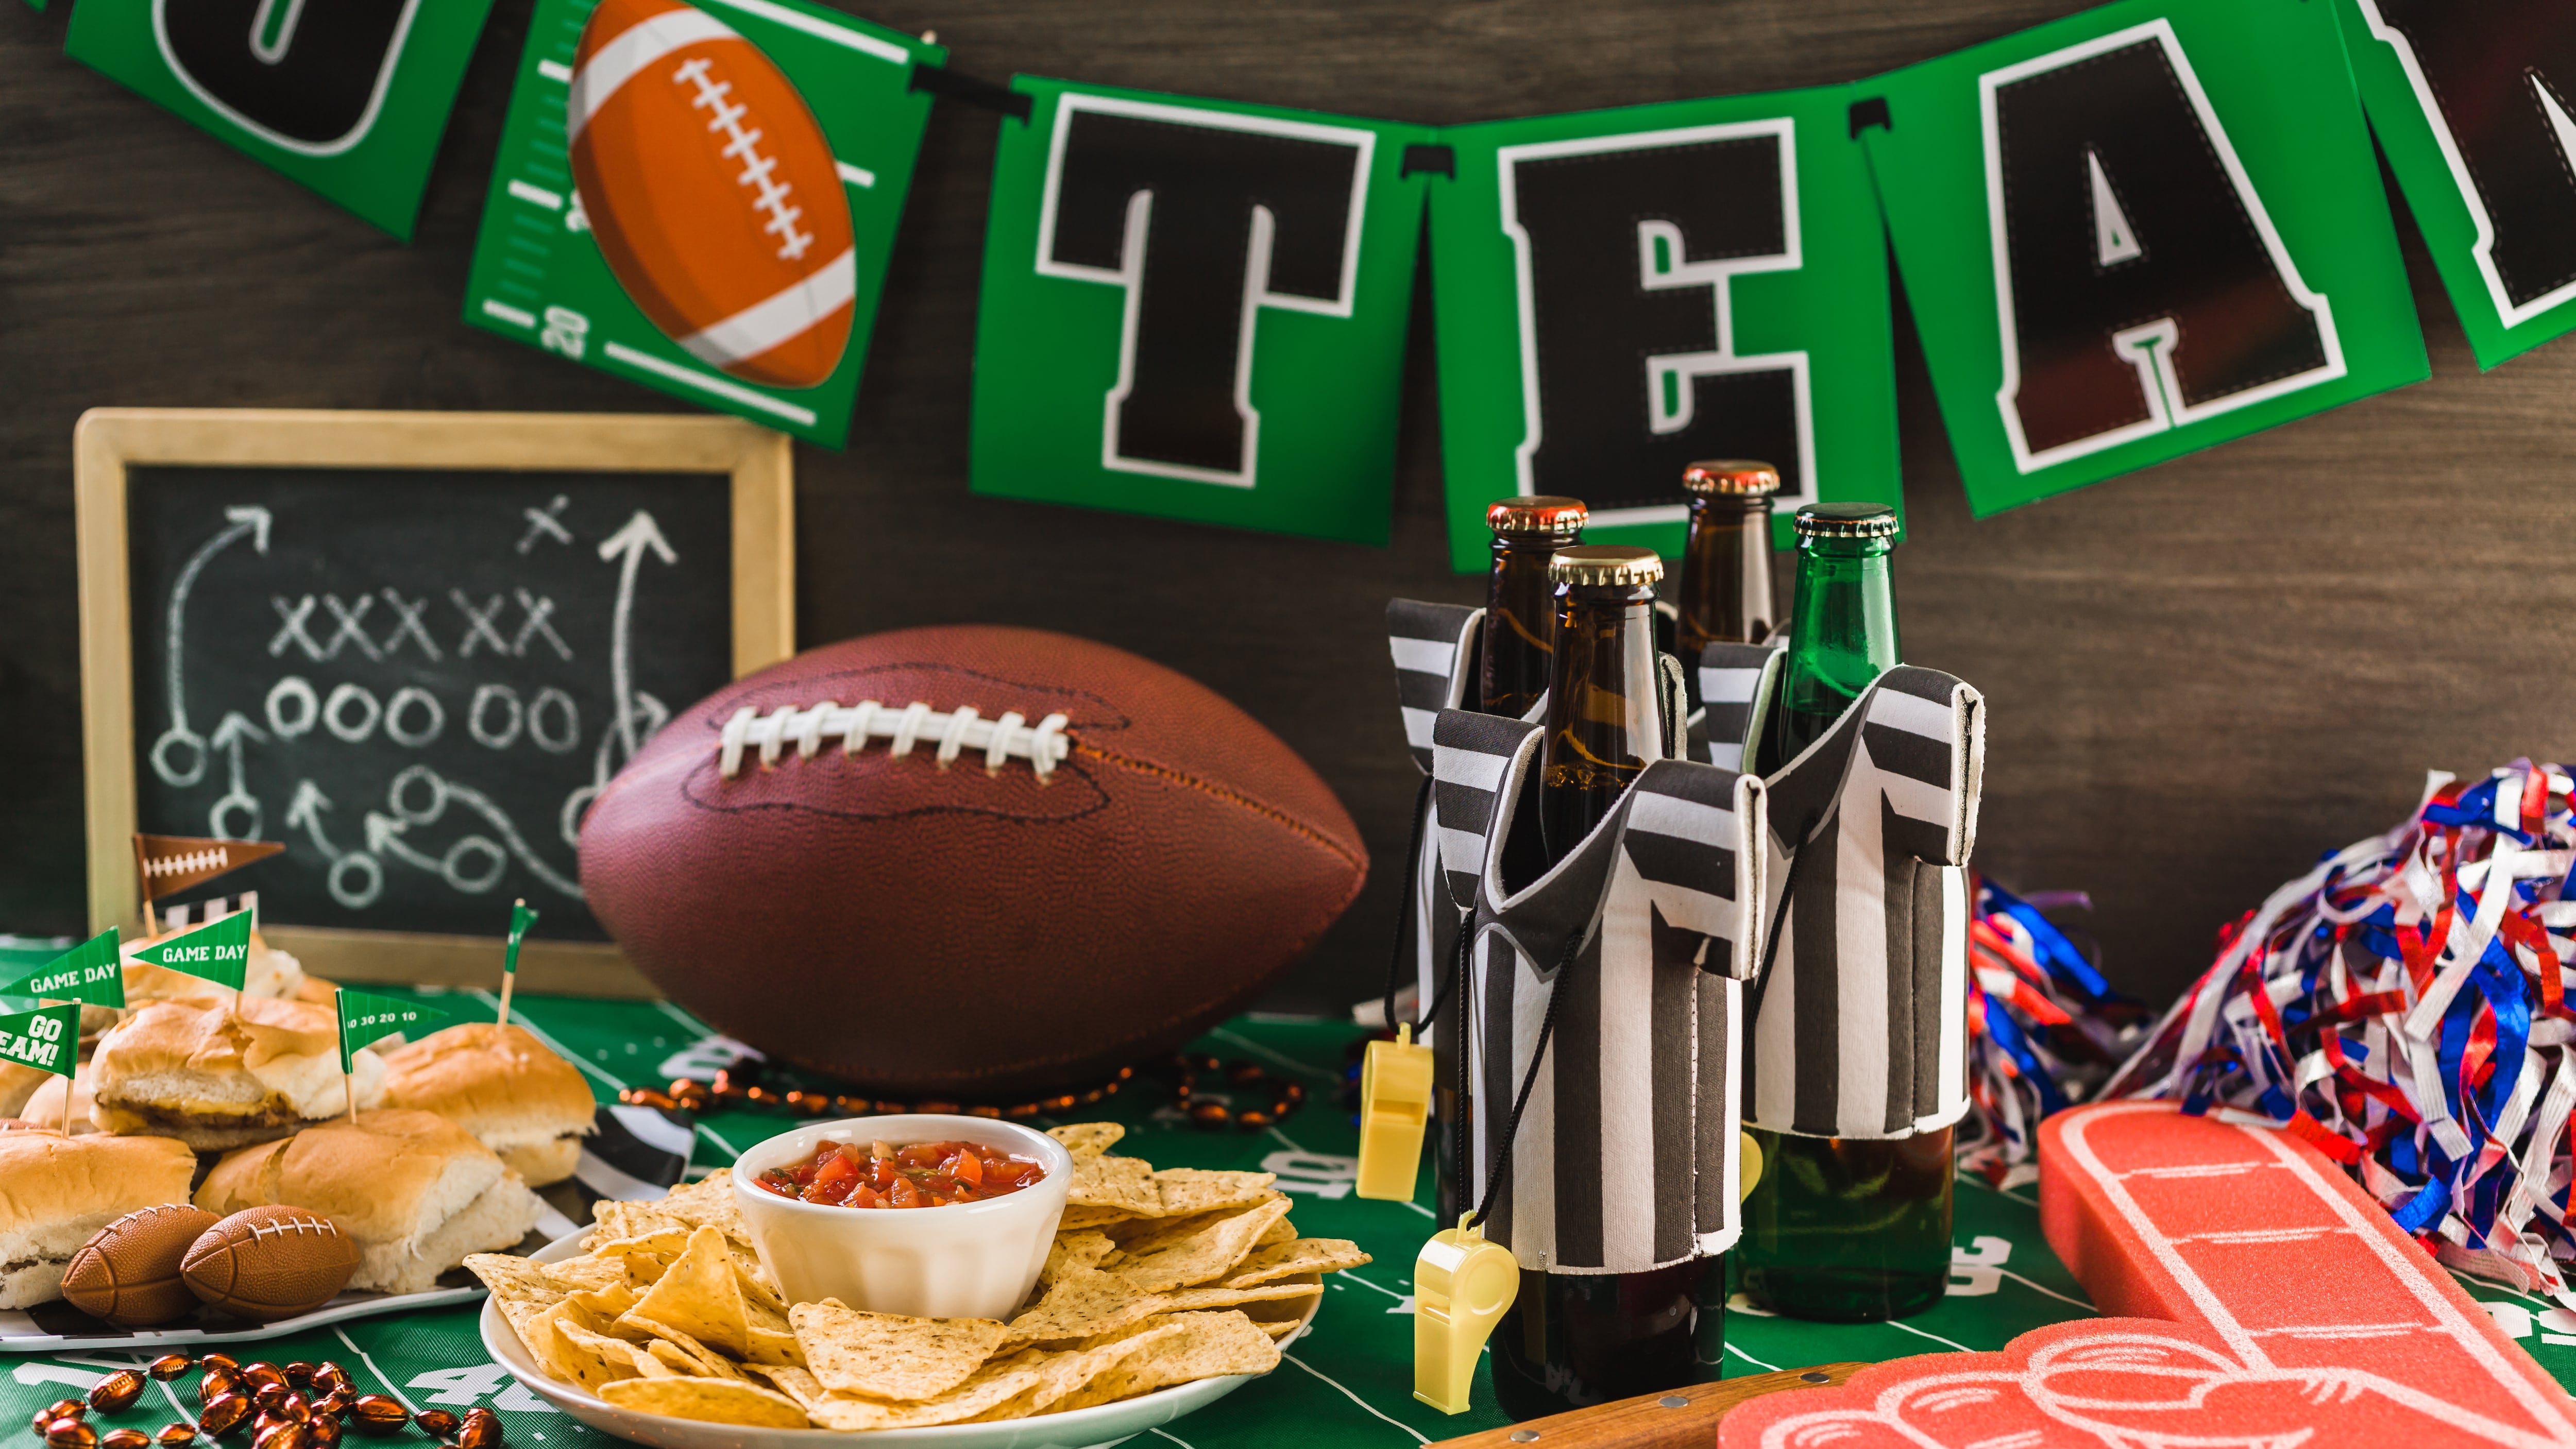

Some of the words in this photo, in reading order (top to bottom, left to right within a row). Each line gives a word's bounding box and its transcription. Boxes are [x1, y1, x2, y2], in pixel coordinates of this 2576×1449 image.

[162, 946, 210, 963] GAME
[215, 944, 246, 961] DAY
[30, 970, 79, 993] GAME
[84, 963, 116, 983] DAY
[28, 1015, 62, 1042] GO
[361, 1015, 375, 1026] 30
[379, 1013, 395, 1023] 20
[401, 1011, 417, 1021] 10
